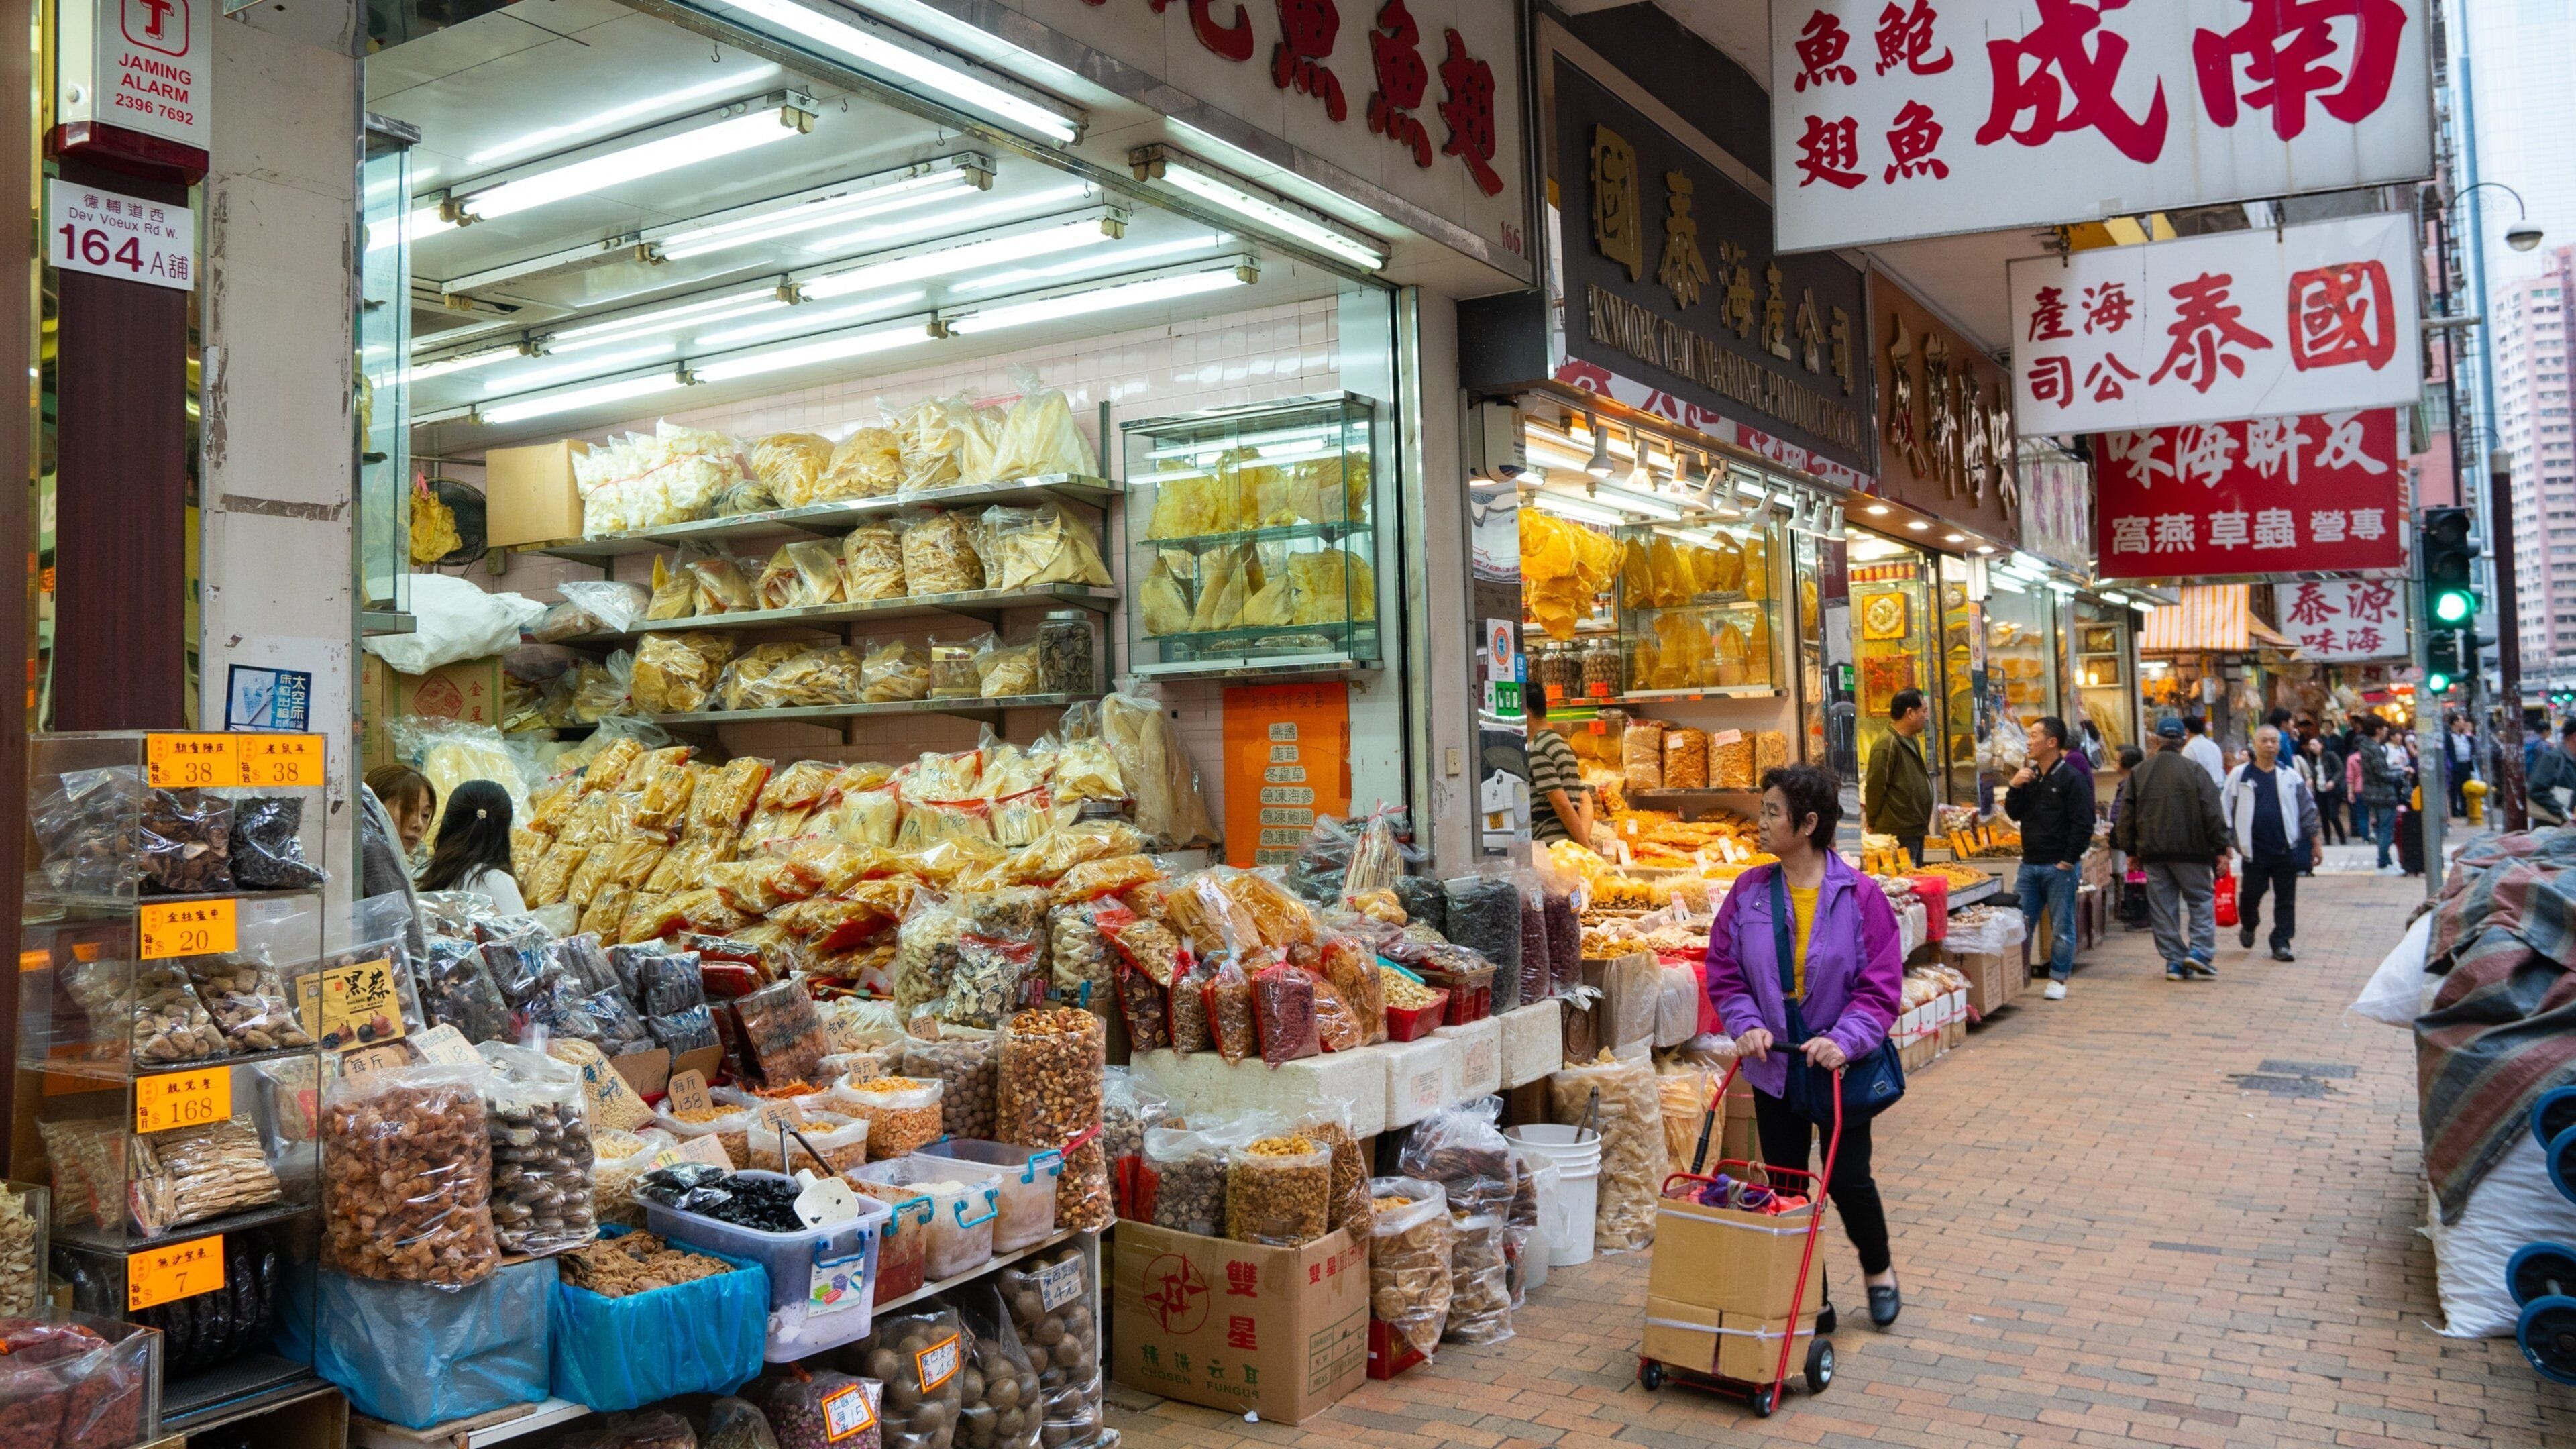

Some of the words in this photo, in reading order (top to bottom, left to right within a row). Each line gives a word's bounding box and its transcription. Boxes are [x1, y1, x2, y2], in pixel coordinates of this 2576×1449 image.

[119, 53, 192, 86] JAMING
[121, 73, 189, 105] ALARM
[115, 93, 154, 114] 2396
[158, 104, 193, 126] 7692
[83, 193, 164, 223] 德輔道西
[68, 206, 93, 221] Dev
[100, 213, 139, 231] Voeux
[144, 222, 162, 236] Rd.
[166, 227, 178, 239] W.
[59, 223, 144, 273] 164
[1500, 219, 1522, 256] 166
[2027, 280, 2135, 343] 海產
[2149, 258, 2398, 394] 國泰
[1589, 284, 1661, 366] KWOK
[1663, 318, 1697, 380] TAI
[1697, 335, 1766, 409] MARINE
[2027, 351, 2142, 409] 公司
[2112, 513, 2196, 555] 燕窩
[2208, 508, 2297, 551] 蟲草
[2310, 508, 2385, 543] 專營
[276, 674, 292, 719] 床位出租
[291, 675, 306, 720] 太空床
[468, 680, 484, 722] 金星
[1271, 724, 1296, 740] 燕盞
[1271, 747, 1297, 761] 鹿茸
[150, 761, 161, 784] 每包
[185, 762, 213, 782] 38
[241, 761, 251, 783] 每包
[272, 762, 299, 782] 38
[1265, 767, 1305, 782] 冬蟲草
[1261, 788, 1313, 804] 急凍海參
[1261, 808, 1313, 825] 急凍鮑翅
[144, 933, 154, 955] 每斤
[180, 930, 209, 951] 20
[343, 967, 390, 1002] 黑蒜
[912, 1018, 932, 1036] 每斤
[350, 1053, 384, 1074] 每斤
[852, 1061, 872, 1075] 每斤
[672, 1075, 696, 1093] 每斤
[171, 1097, 213, 1123] 168
[678, 1092, 704, 1112] 138
[140, 1106, 149, 1129] 每斤
[1309, 1255, 1336, 1285] 雙星
[175, 1272, 189, 1293] 7
[1226, 1259, 1258, 1351] 雙星
[1141, 1366, 1192, 1386] CHOSEN
[1206, 1380, 1260, 1399] FUNGUS
[851, 1405, 865, 1425] 15
